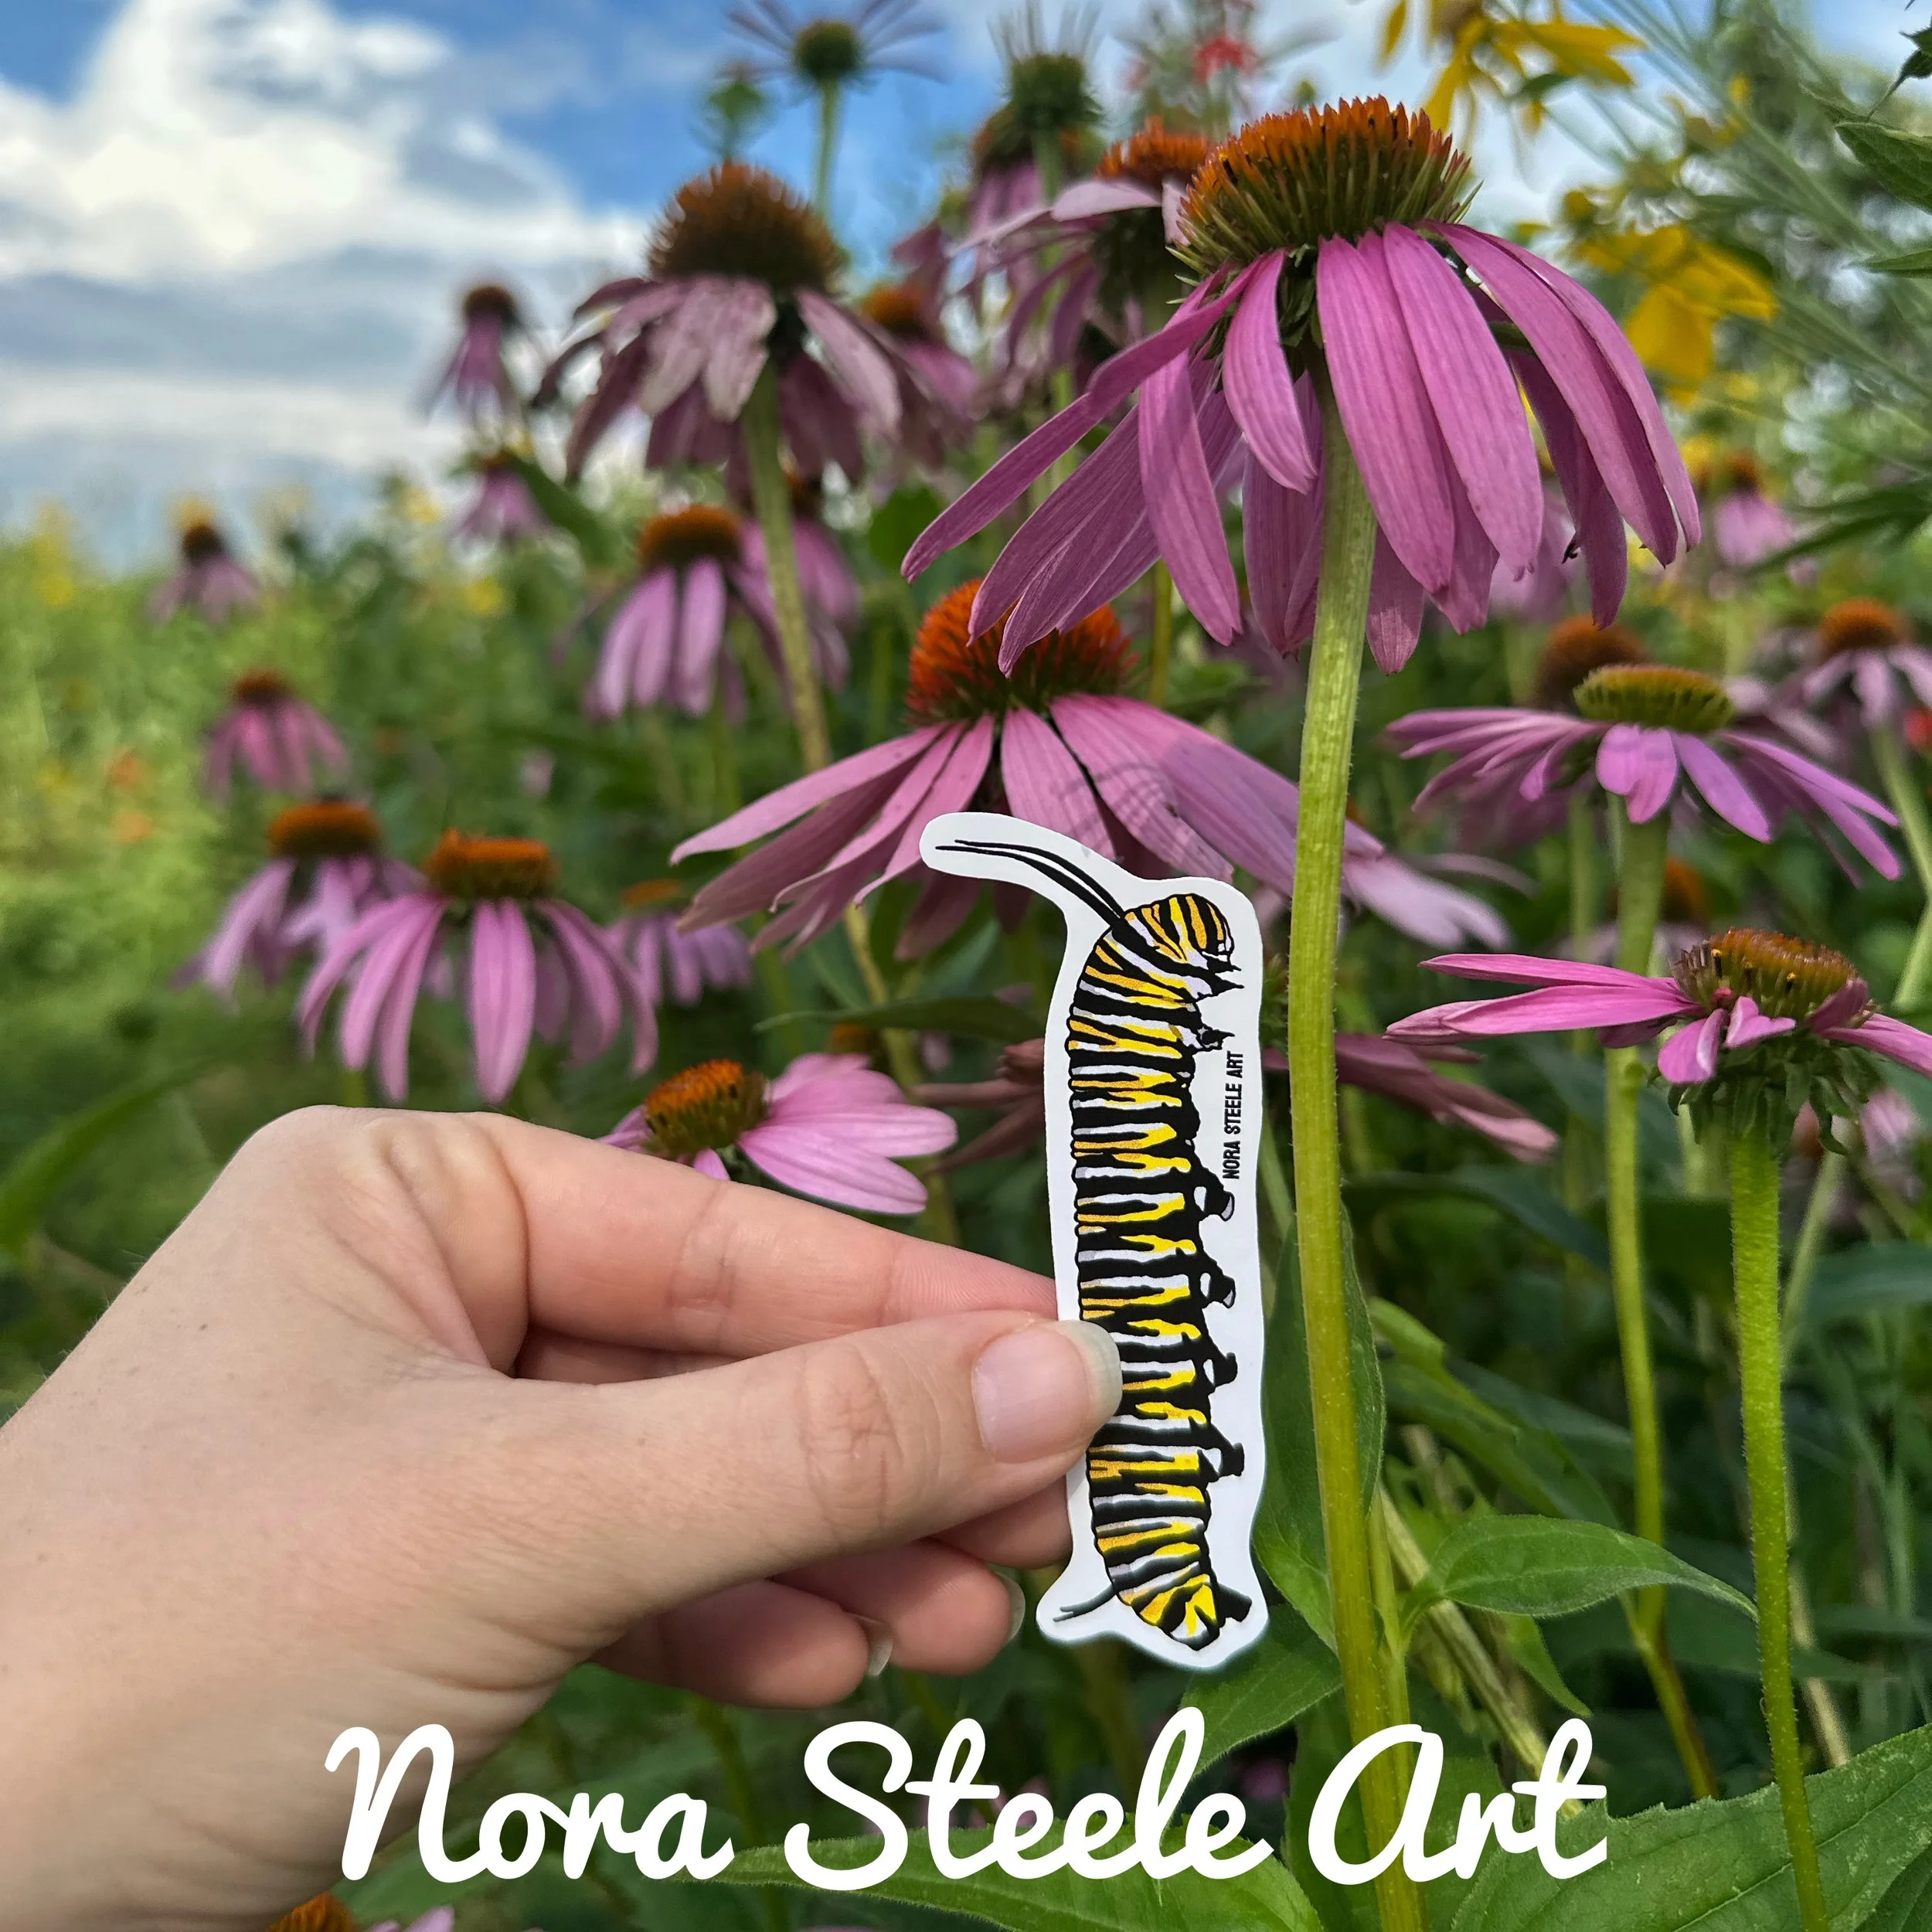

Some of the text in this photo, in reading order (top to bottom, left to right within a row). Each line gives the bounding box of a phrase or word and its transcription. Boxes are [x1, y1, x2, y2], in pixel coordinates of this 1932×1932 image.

[1223, 1050, 1243, 1179] NORA STEELE ART
